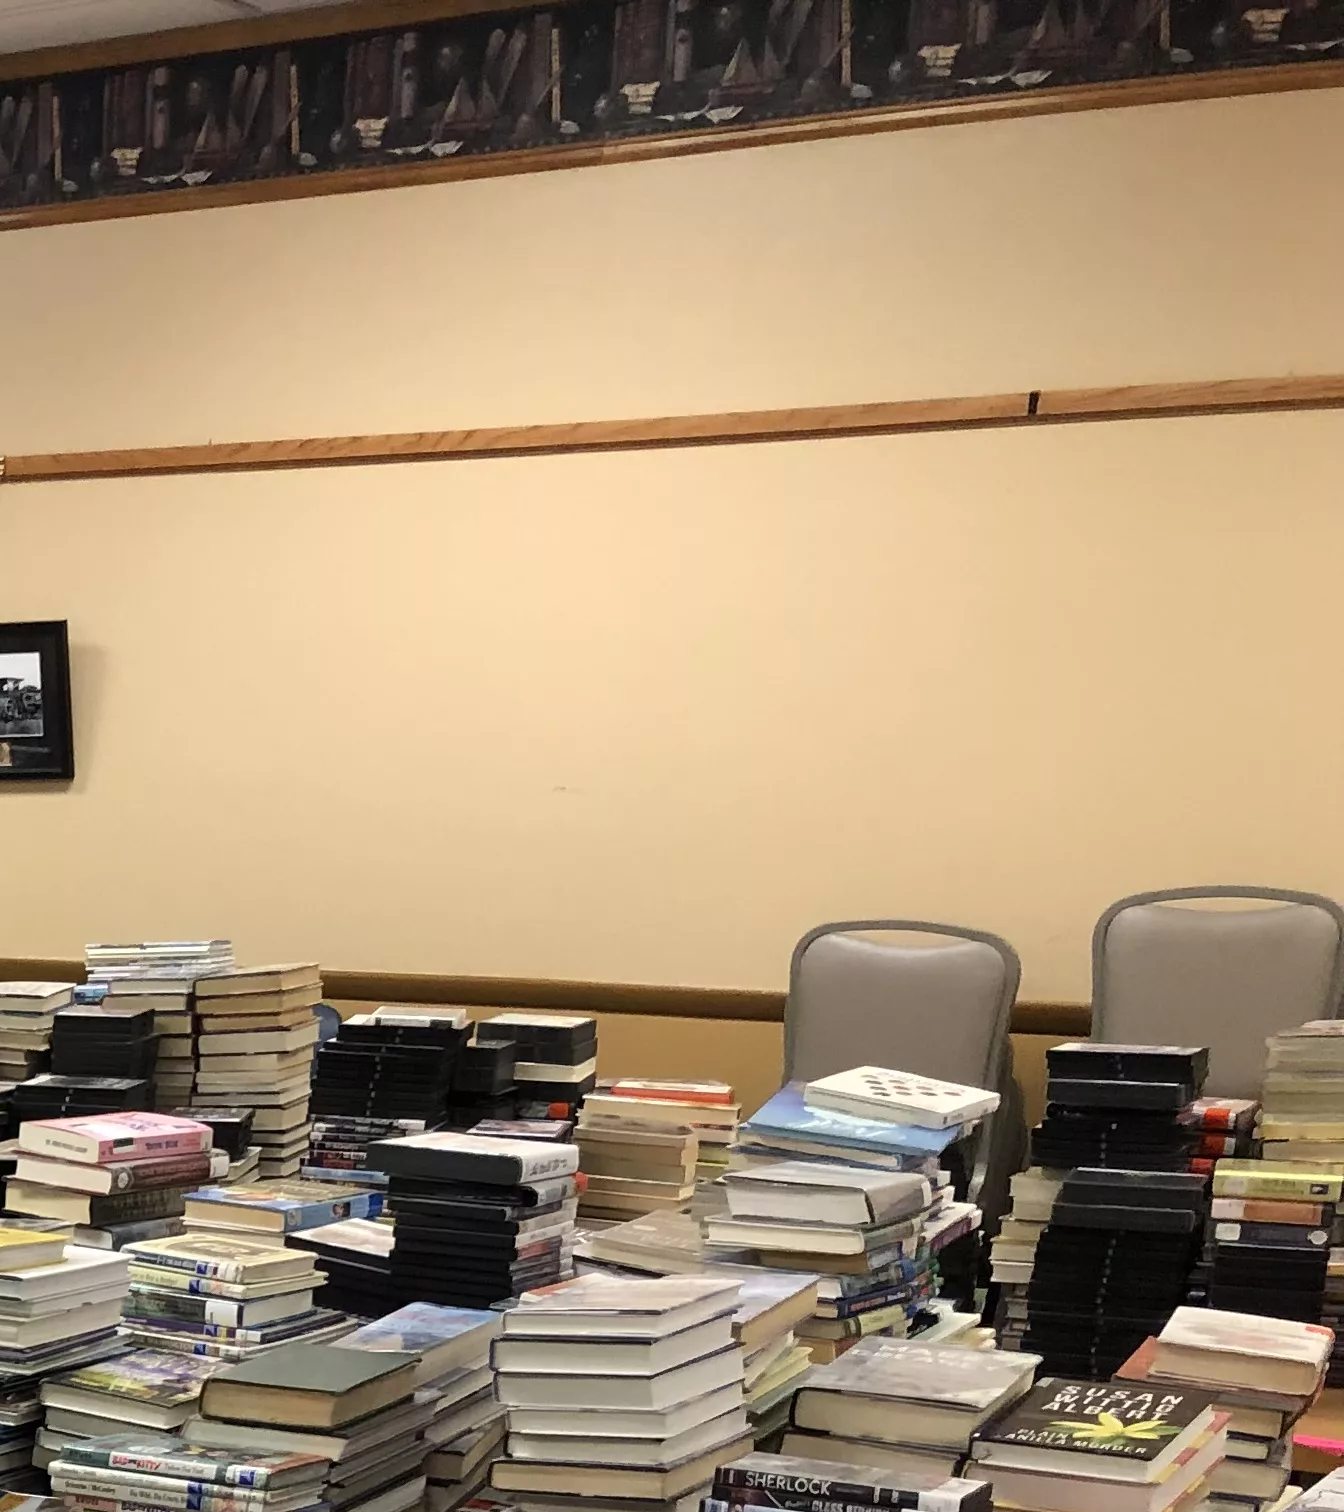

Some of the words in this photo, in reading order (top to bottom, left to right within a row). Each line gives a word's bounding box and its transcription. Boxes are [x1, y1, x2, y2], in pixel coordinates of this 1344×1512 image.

[1053, 1393, 1176, 1412] WITTIG
[1060, 1385, 1184, 1405] SUSAN
[1042, 1401, 1169, 1421] ALBERT
[1073, 1440, 1147, 1454] MURDER
[745, 1471, 831, 1496] SHERLOCK
